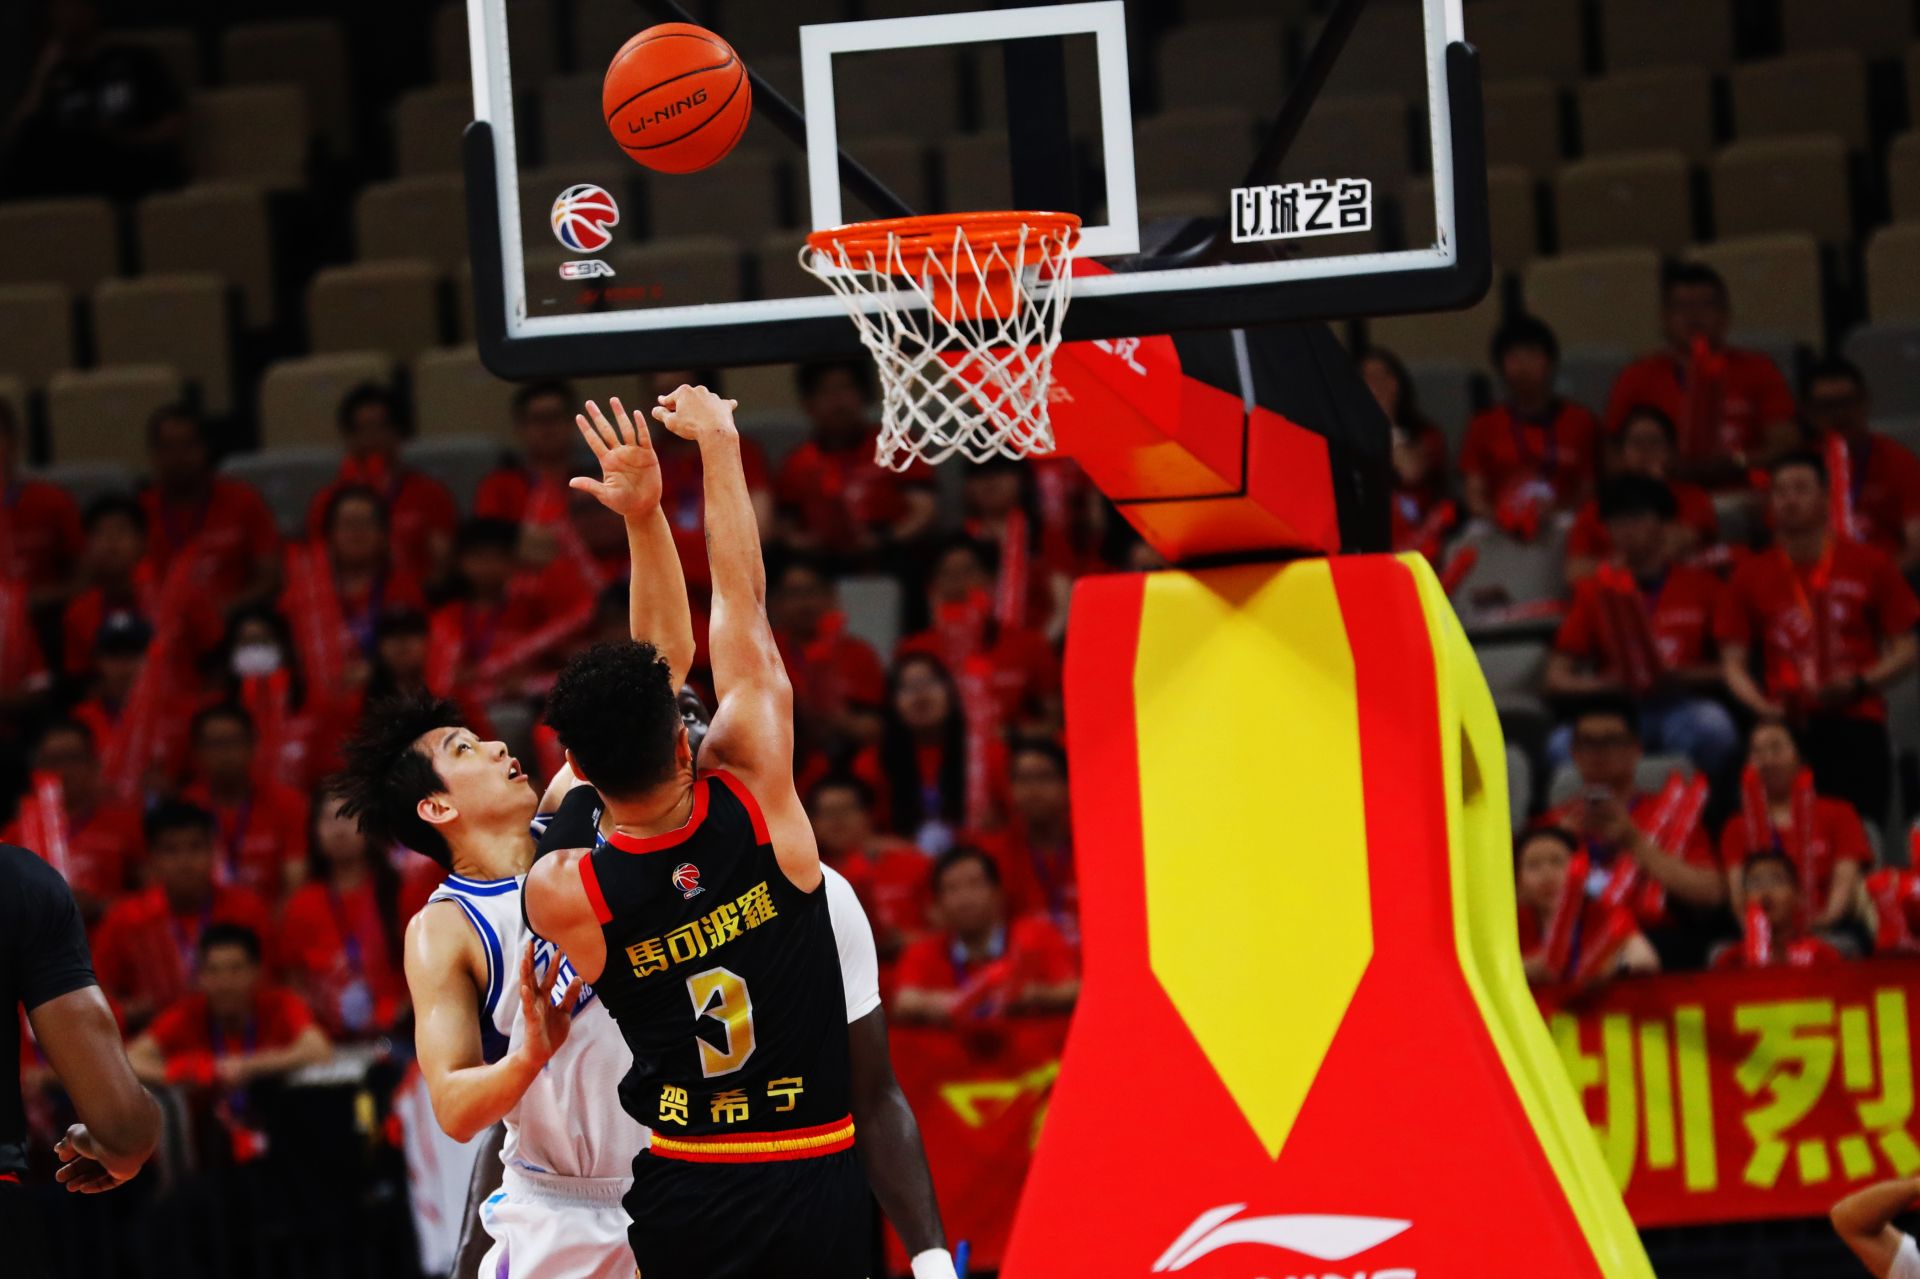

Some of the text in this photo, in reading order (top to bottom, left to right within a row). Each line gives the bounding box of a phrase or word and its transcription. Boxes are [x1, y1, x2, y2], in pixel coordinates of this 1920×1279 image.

[627, 87, 708, 134] LI-NING
[1234, 181, 1368, 240] 以城之名
[559, 260, 616, 280] CBA
[625, 880, 778, 978] 馬可波羅
[686, 966, 757, 1079] 3
